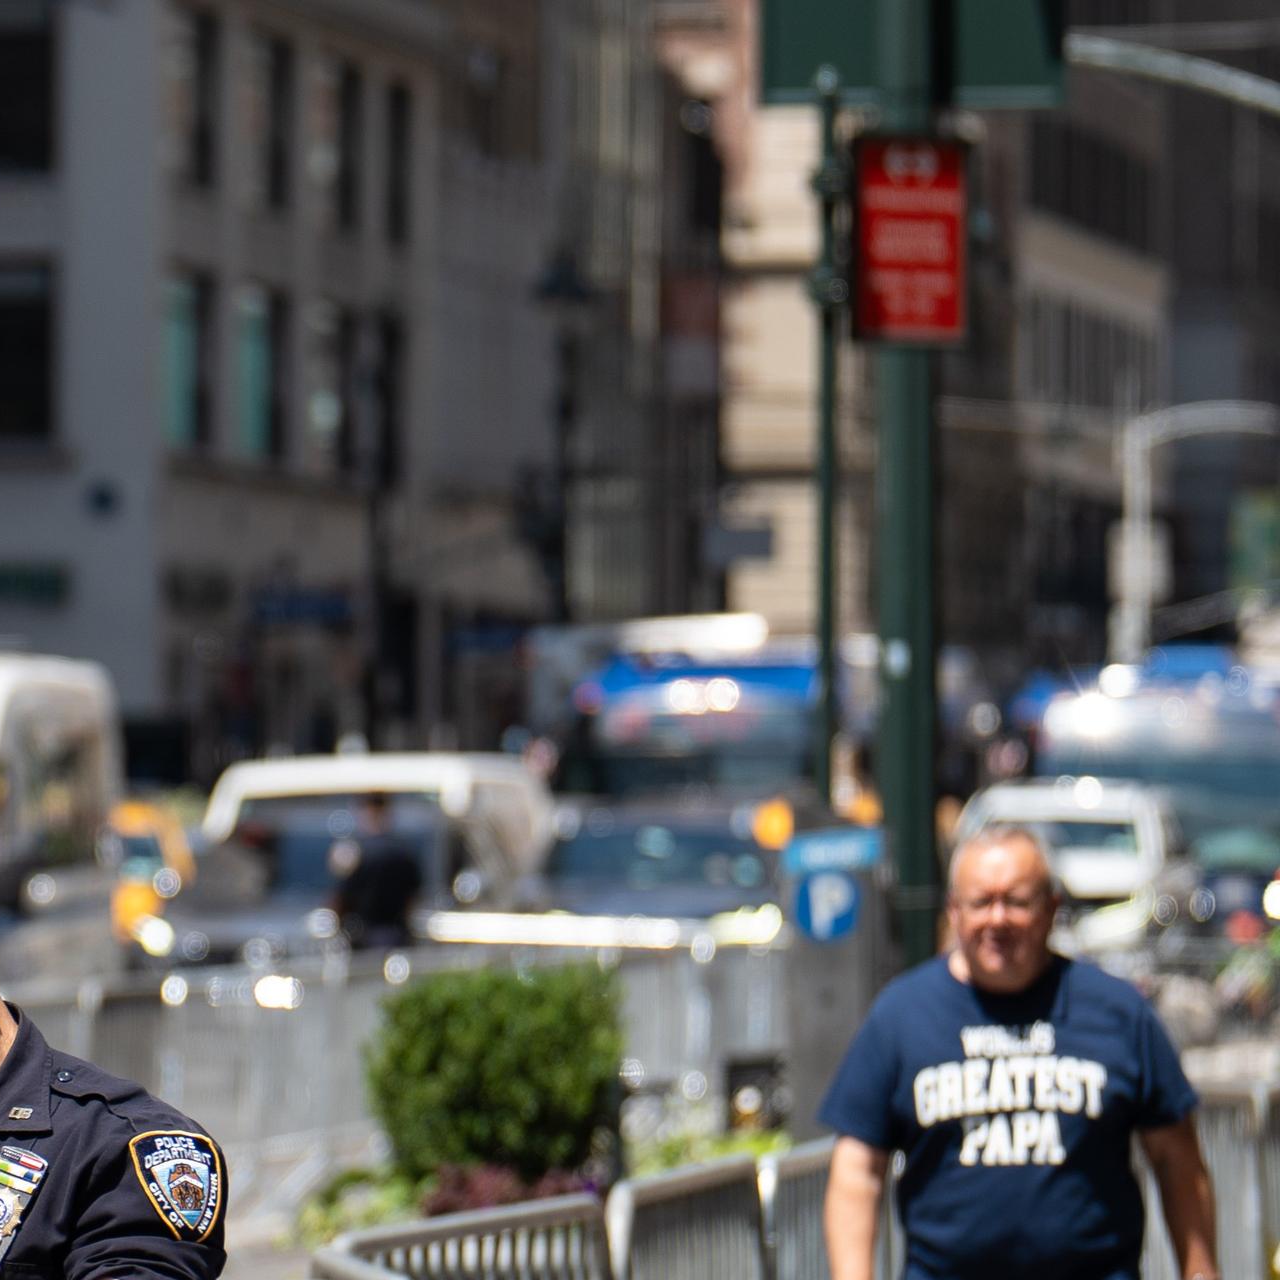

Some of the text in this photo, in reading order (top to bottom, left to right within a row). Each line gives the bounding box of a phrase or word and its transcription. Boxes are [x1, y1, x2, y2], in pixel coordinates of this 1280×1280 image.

[913, 1055, 1107, 1128] GREATEST
[154, 1137, 196, 1151] POLICE
[958, 1112, 1067, 1167] PAPA
[144, 1147, 212, 1170] DEPARTMENT
[148, 1182, 185, 1229] CITY OF
[197, 1208, 215, 1234] NEW
